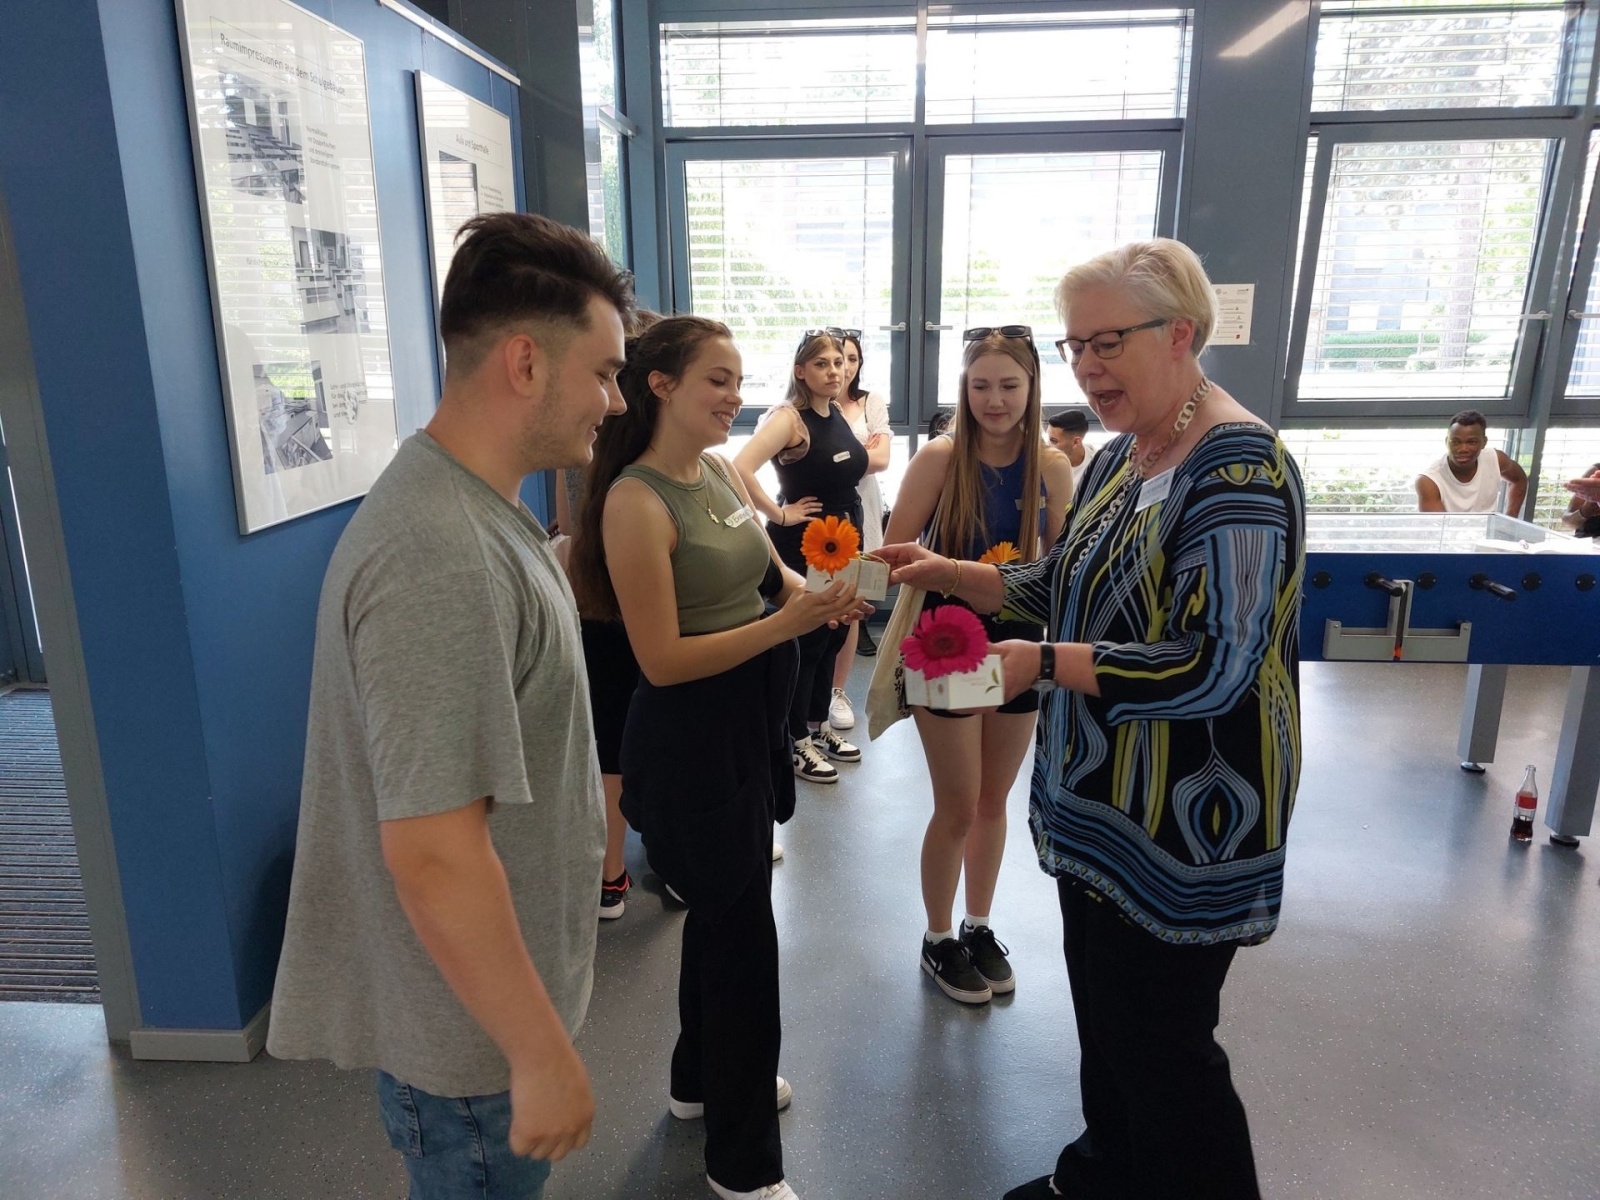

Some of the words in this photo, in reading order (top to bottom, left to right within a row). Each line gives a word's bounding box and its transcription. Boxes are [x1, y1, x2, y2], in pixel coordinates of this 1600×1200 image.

[220, 32, 284, 70] Raumimpressionen
[284, 62, 295, 76] aus
[295, 65, 309, 80] dem
[472, 140, 490, 155] Sporthalle
